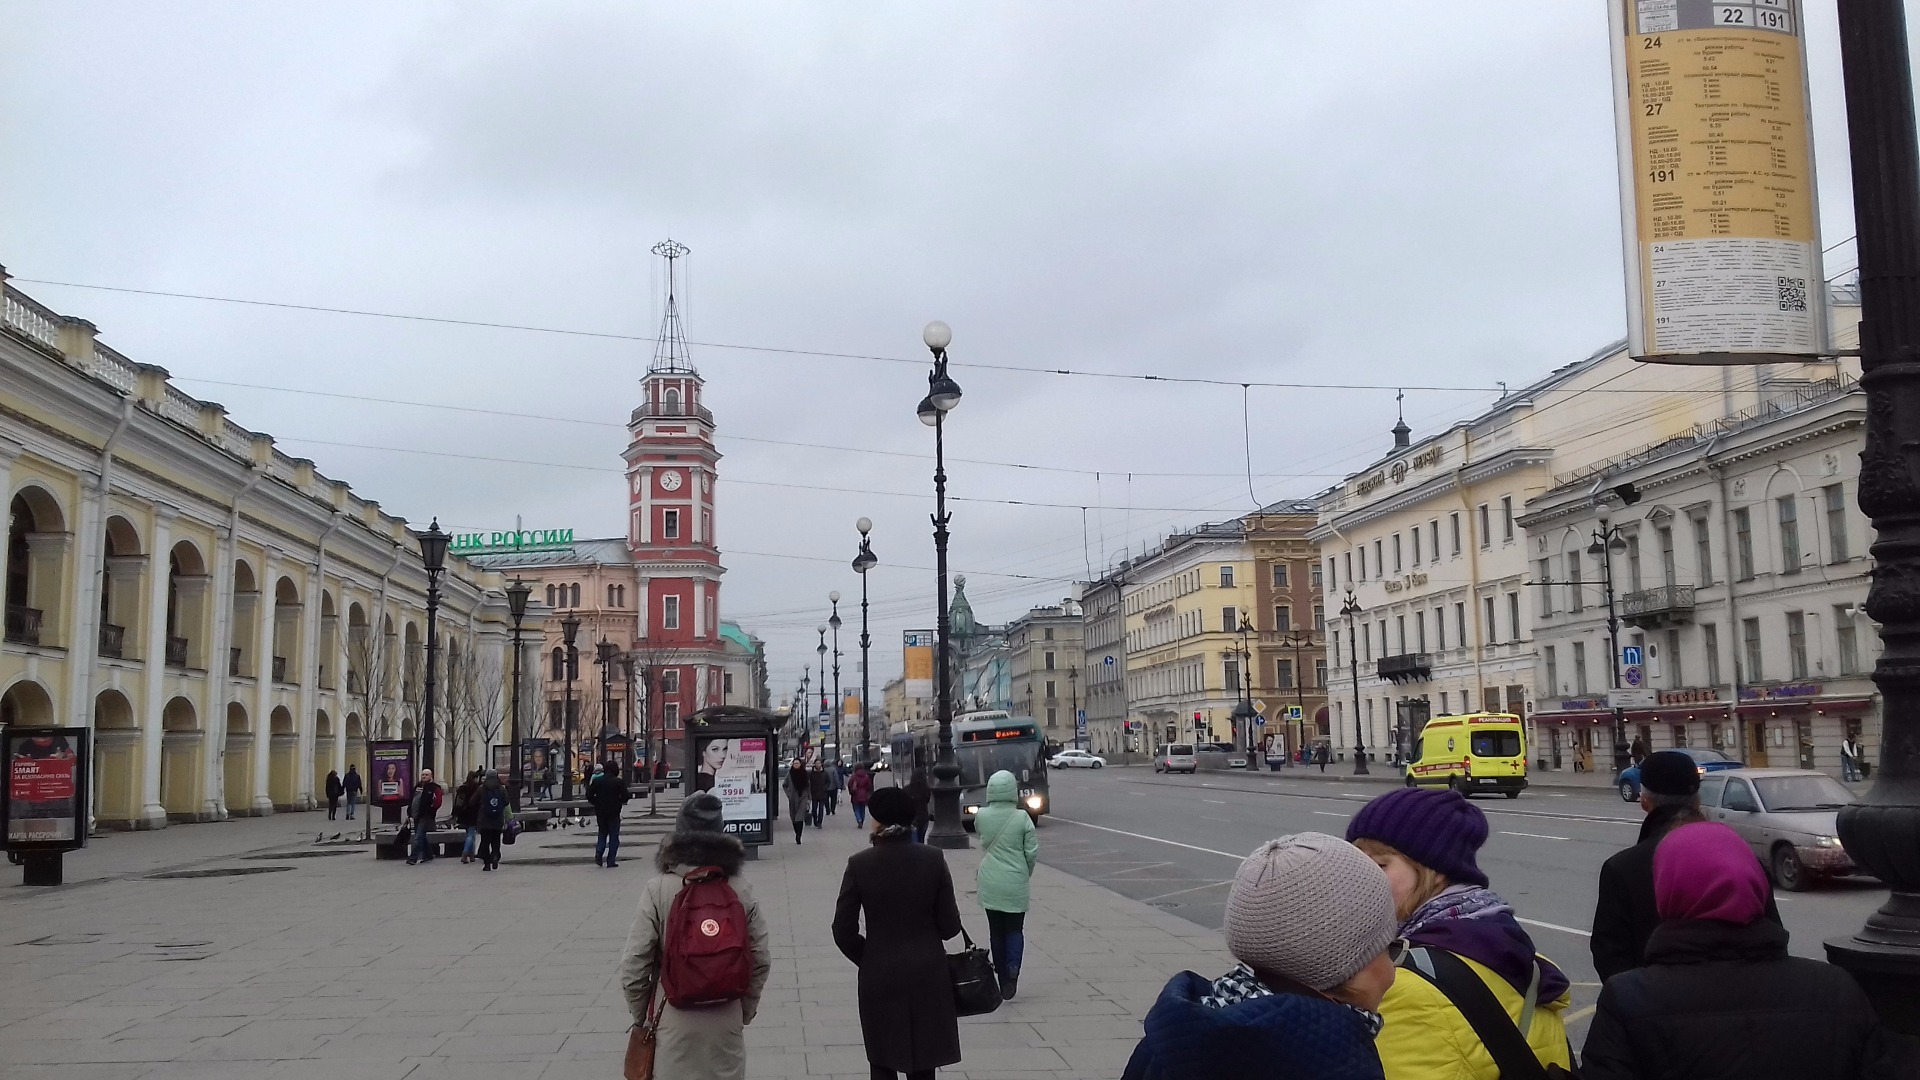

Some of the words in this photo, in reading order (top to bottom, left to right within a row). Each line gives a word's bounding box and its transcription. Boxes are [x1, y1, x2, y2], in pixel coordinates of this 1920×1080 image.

[1723, 8, 1744, 23] 22
[1760, 11, 1784, 29] 191
[1644, 36, 1662, 50] 24
[1645, 103, 1663, 117] 27
[1649, 169, 1675, 183] 191
[450, 533, 485, 549] НК
[491, 528, 573, 548] РОССИИ
[14, 766, 40, 774] SMART
[722, 823, 737, 833] ИВ
[738, 822, 761, 832] ГОШ
